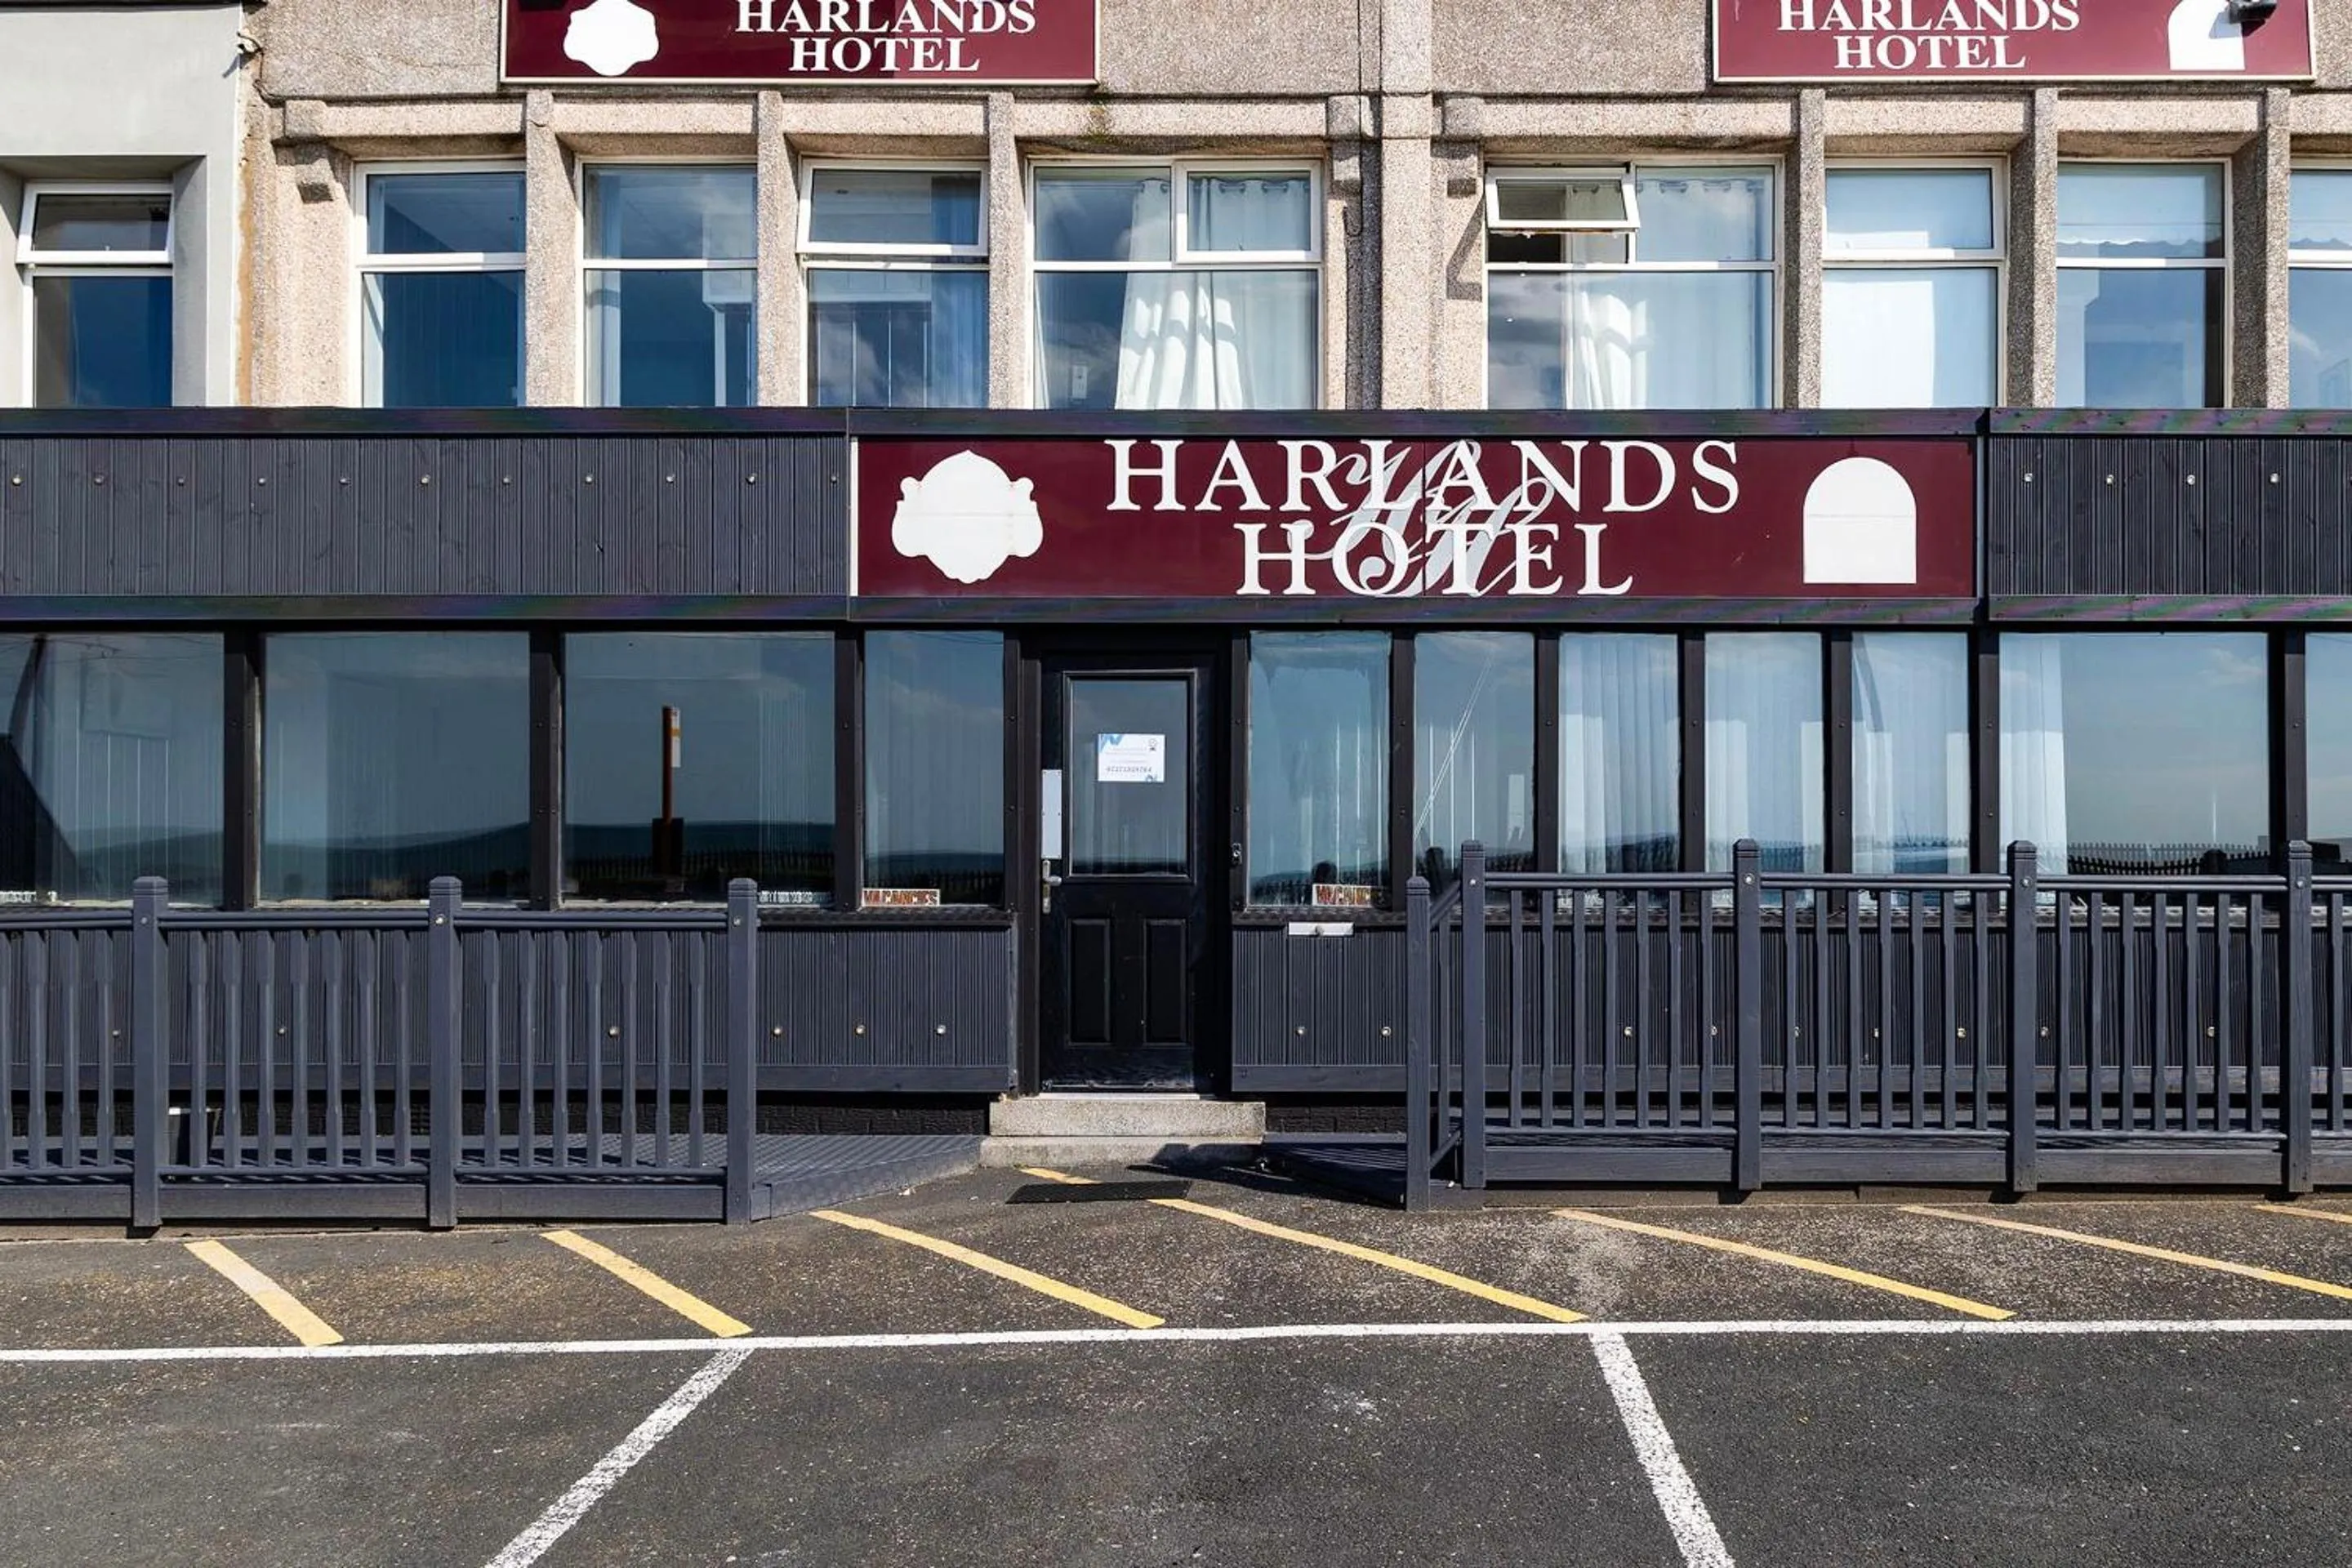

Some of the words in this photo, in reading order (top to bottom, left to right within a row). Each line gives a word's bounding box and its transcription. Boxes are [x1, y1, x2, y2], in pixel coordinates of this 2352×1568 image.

[736, 0, 1036, 33] HARLANDS
[1778, 0, 2079, 30] HARLANDS
[789, 38, 979, 72] HOTEL
[1833, 35, 2025, 69] HOTEL
[1105, 439, 1740, 513] HARLANDS
[1234, 523, 1633, 596] HOTEL
